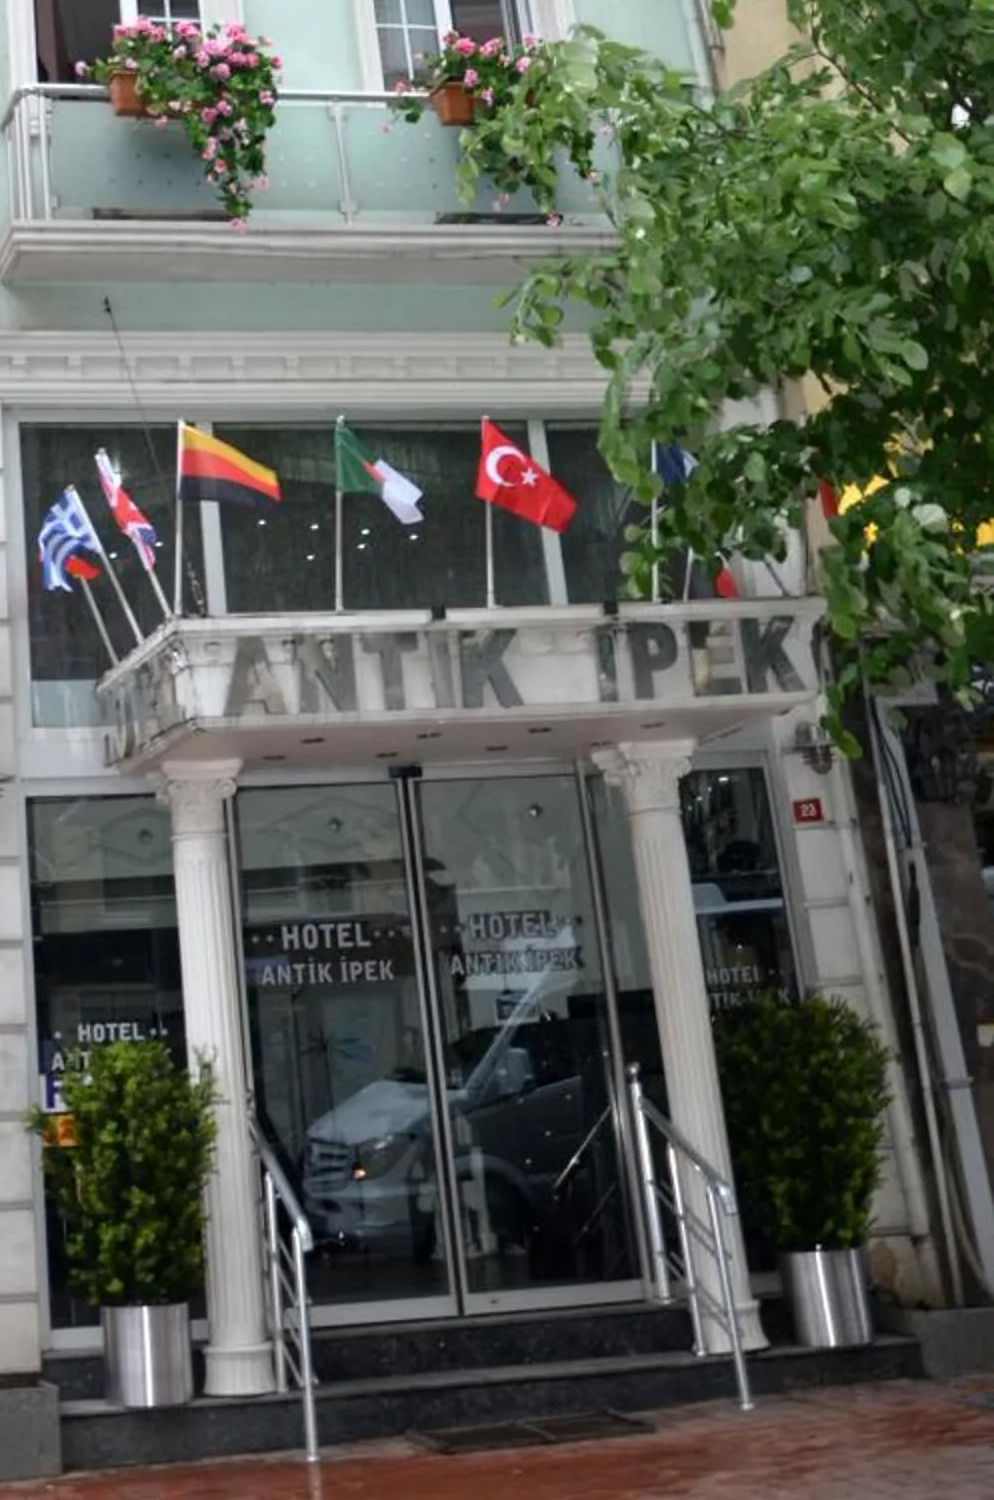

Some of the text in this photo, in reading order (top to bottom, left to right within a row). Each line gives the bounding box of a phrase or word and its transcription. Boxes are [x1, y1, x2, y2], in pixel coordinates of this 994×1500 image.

[281, 922, 373, 951] HOTEL
[469, 912, 557, 940] HOTEL
[77, 1022, 145, 1043] HOTEL
